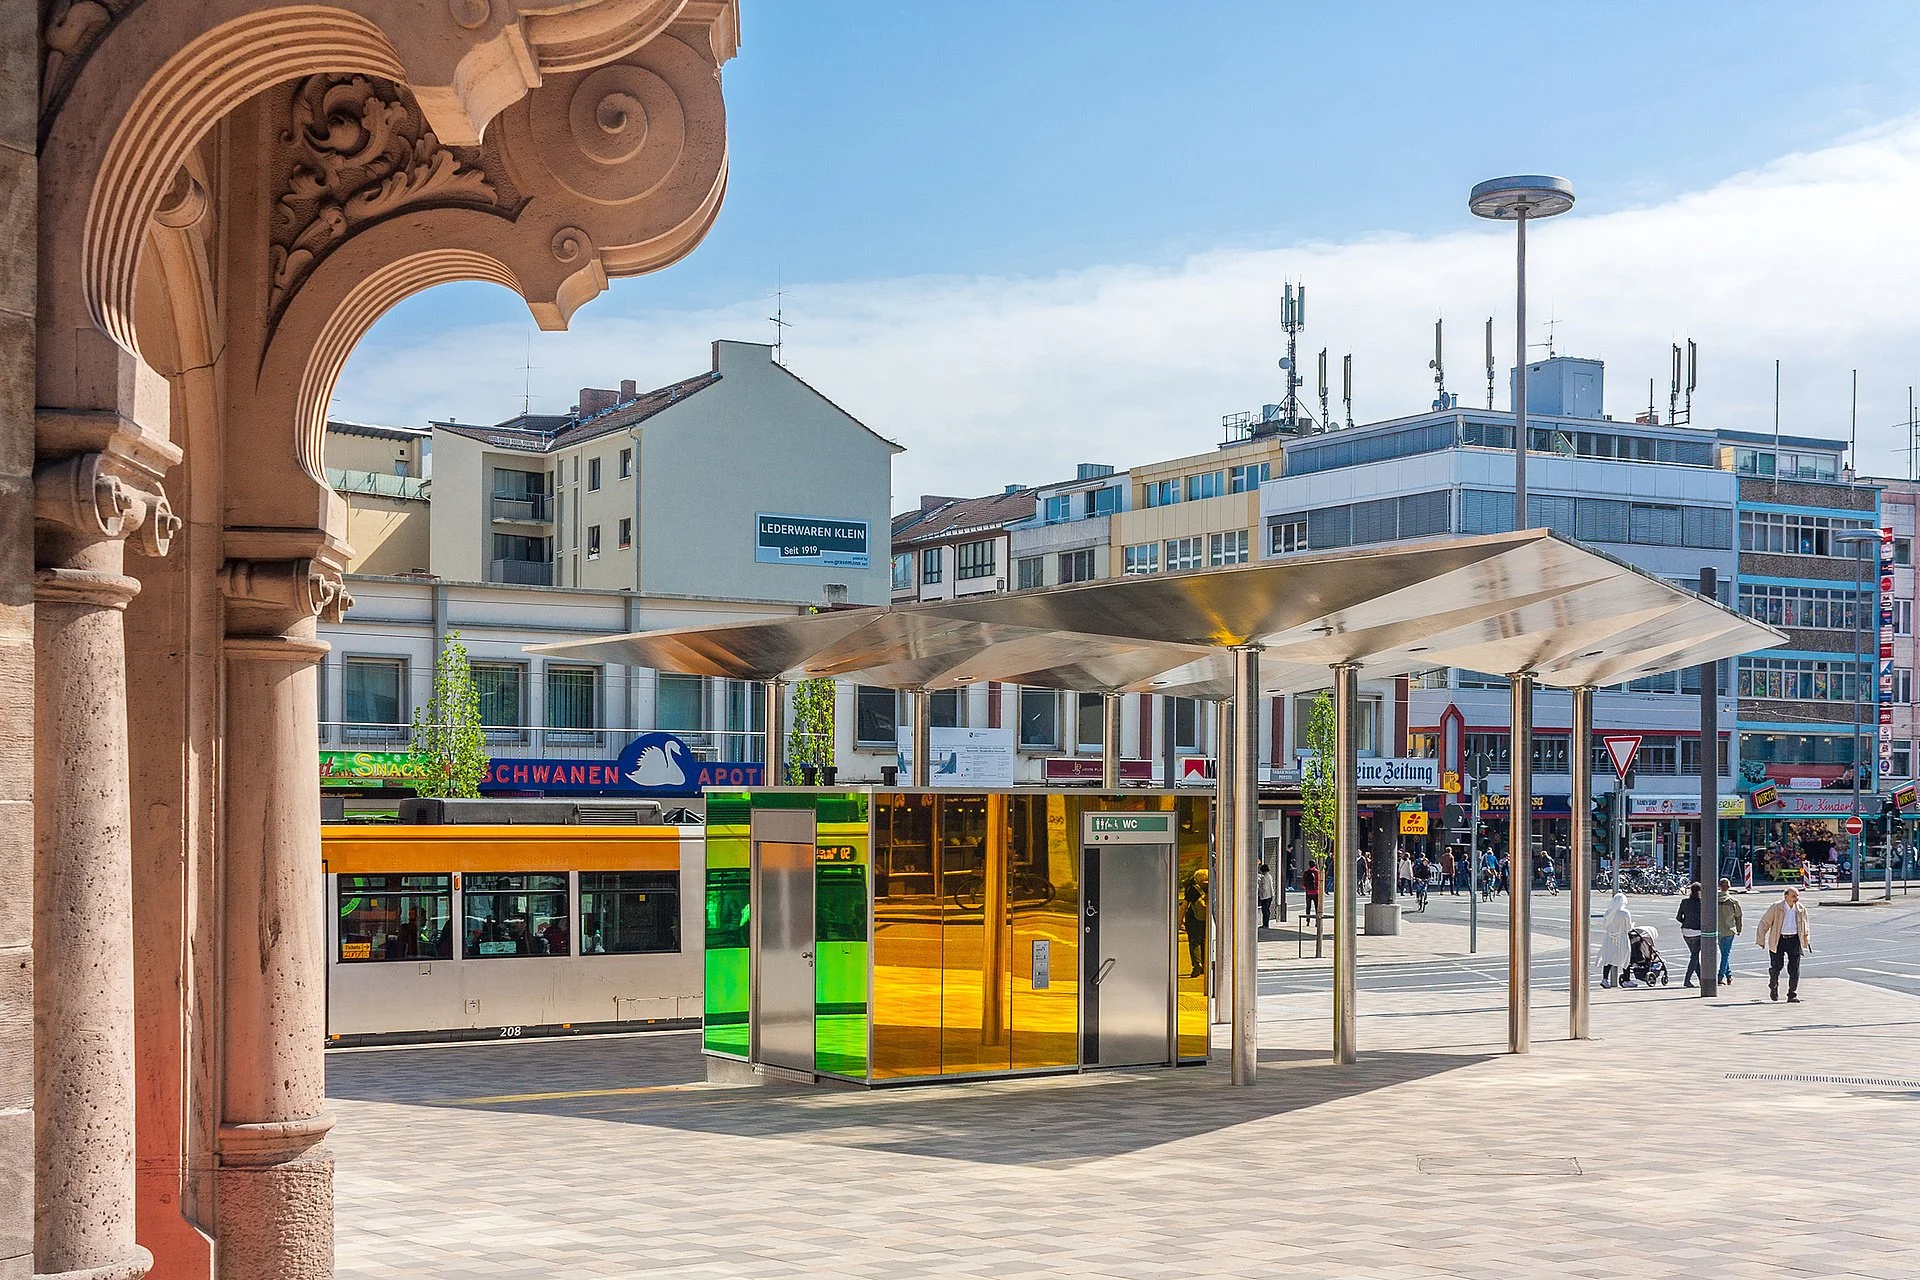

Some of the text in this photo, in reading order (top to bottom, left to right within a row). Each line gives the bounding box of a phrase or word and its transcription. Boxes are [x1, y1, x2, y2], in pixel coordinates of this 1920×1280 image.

[761, 522, 865, 539] LEDERWAREN KLEIN
[784, 545, 818, 555] Seit 1919
[481, 764, 766, 785] SCHWANEN APOT
[1384, 761, 1433, 784] Zeitung
[1756, 788, 1776, 805] WIRTH
[1897, 791, 1916, 807] WIRTH
[1794, 798, 1812, 812] Der
[1122, 820, 1138, 829] WC
[500, 1026, 521, 1038] 208
